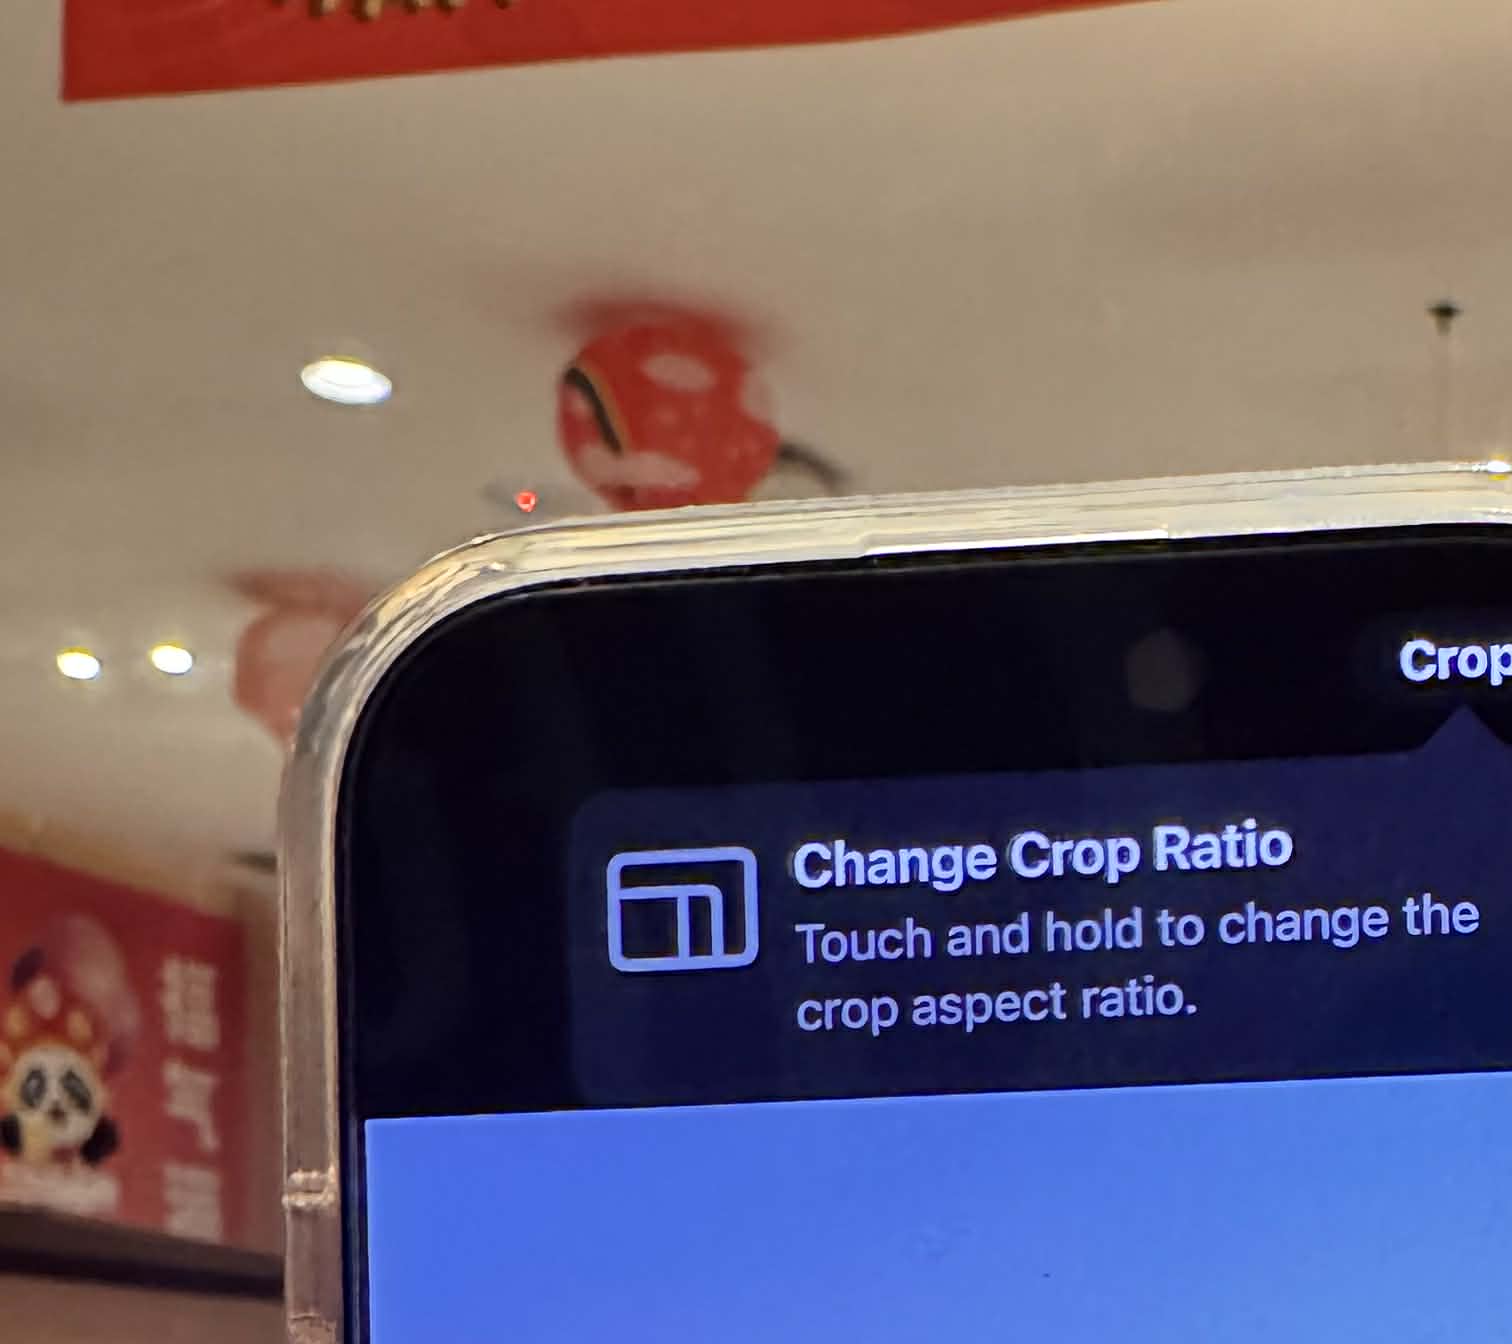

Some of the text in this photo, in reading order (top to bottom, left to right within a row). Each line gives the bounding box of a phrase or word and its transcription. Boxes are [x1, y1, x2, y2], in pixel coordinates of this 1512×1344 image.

[792, 817, 1294, 893] Change Crop Ratio
[794, 892, 1480, 964] Touch and hold to change the
[796, 974, 1197, 1037] crop aspect ratio.
